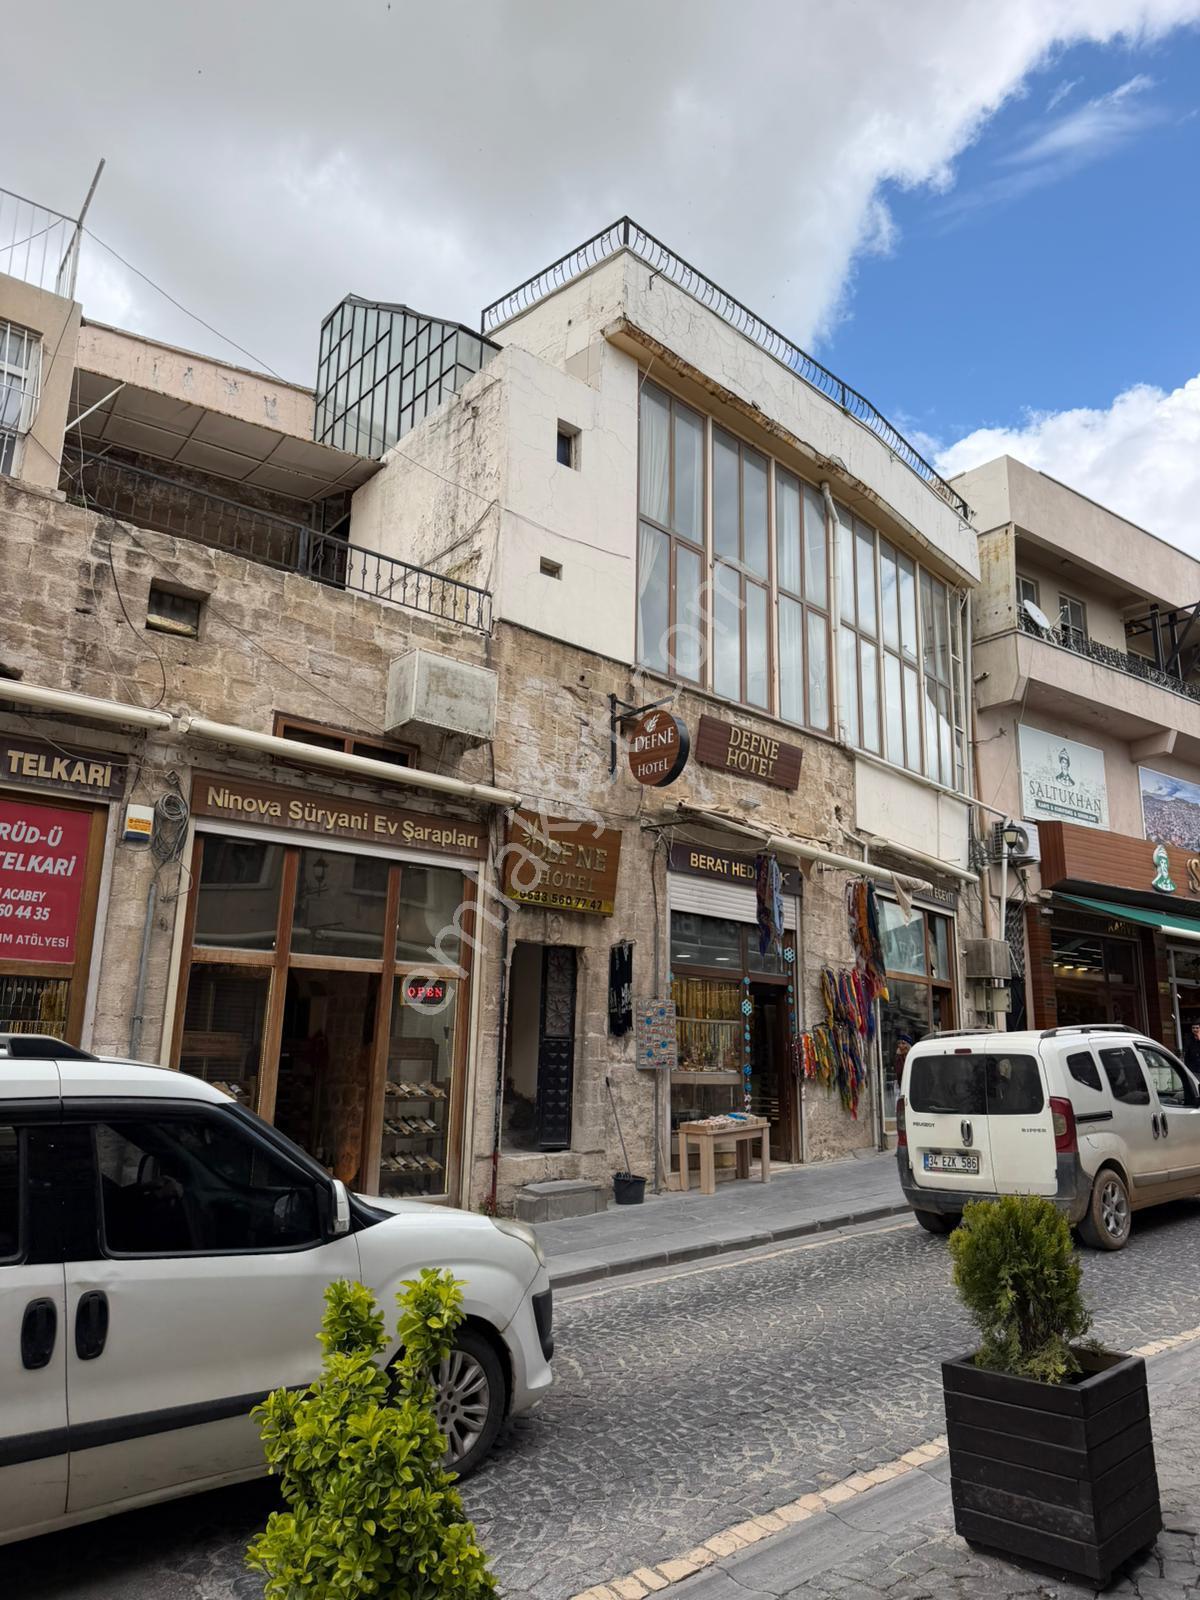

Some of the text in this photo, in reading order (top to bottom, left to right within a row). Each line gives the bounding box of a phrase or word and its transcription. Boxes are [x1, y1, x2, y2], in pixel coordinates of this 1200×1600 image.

[634, 726, 675, 753] DEFNE
[729, 726, 780, 760] DEFNE
[7, 749, 113, 787] TELKARİ
[638, 758, 669, 777] HOTEL
[726, 747, 776, 778] HOTEL
[1029, 780, 1102, 812] SALTUKHAN
[207, 786, 478, 848] Ninova Süryani Ev Şarapları
[690, 852, 729, 874] BERAT
[539, 870, 596, 894] HOTEL
[2, 888, 46, 903] ACABEY
[551, 893, 572, 905] 560
[590, 900, 603, 910] 47
[15, 905, 32, 919] 44
[33, 907, 51, 921] 35
[16, 933, 69, 948] ATÖLYESİ
[407, 986, 443, 999] OPEN
[928, 1155, 977, 1169] 34 EZK 586
